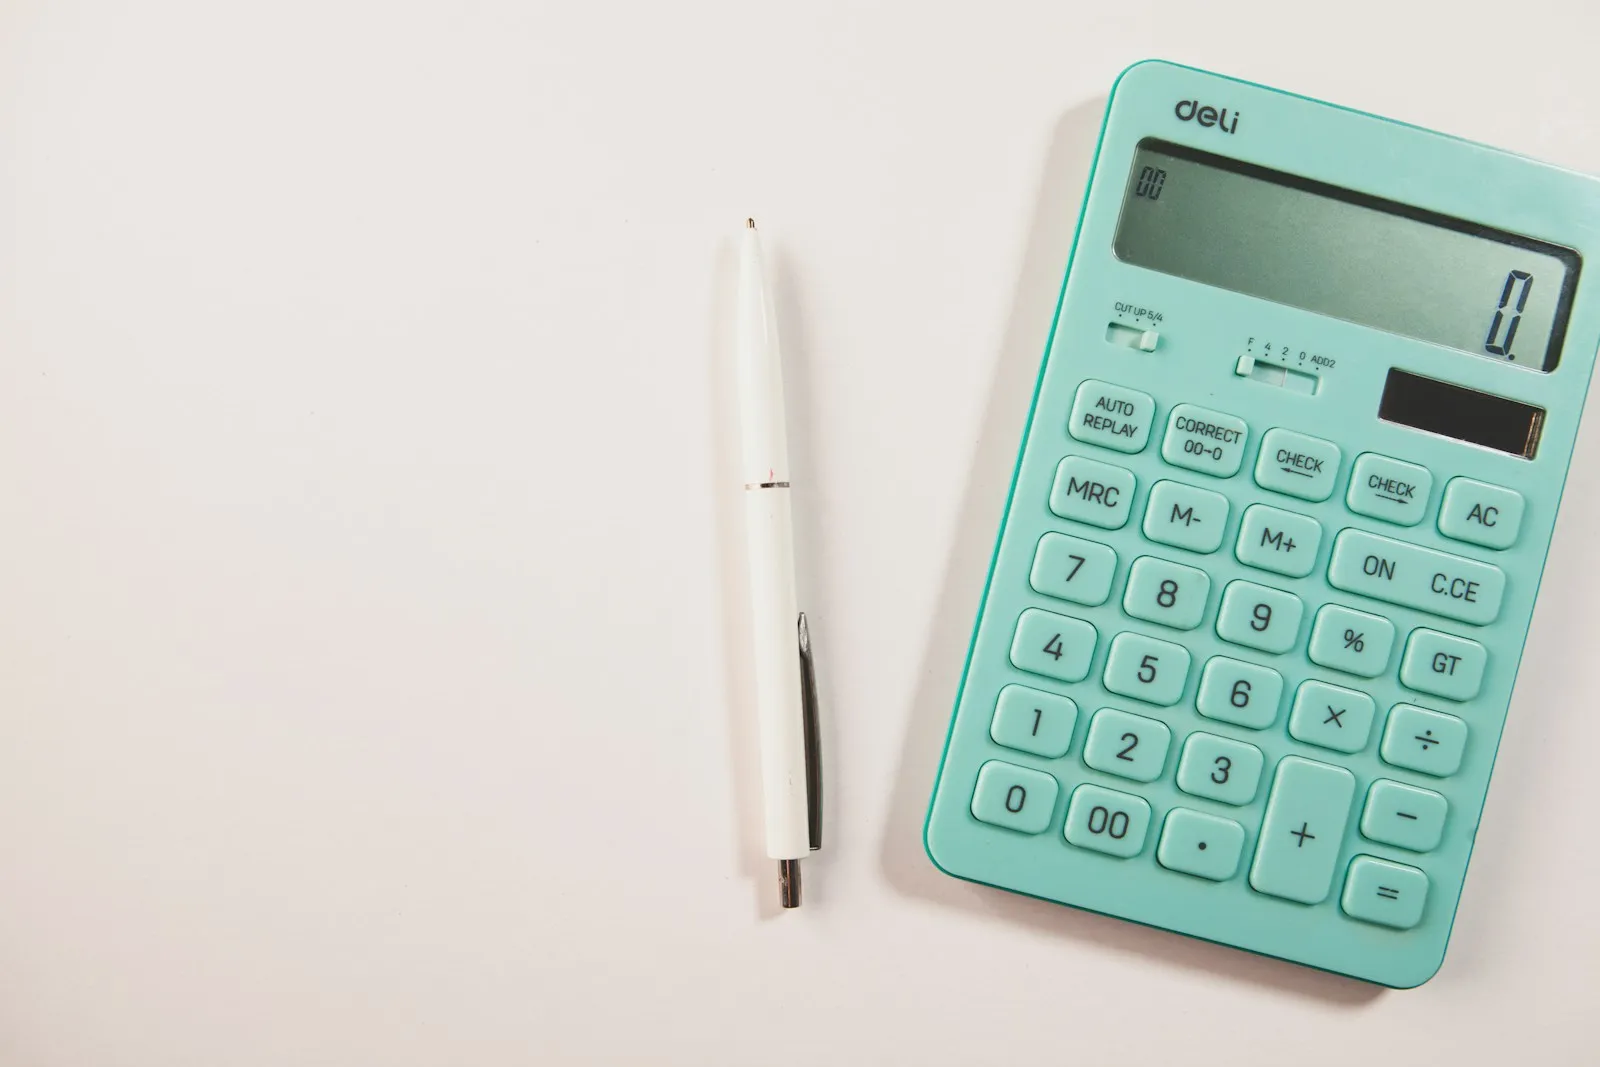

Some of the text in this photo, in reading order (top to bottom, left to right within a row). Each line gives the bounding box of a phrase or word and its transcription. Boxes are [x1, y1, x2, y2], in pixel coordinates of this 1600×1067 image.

[1175, 100, 1239, 134] deli
[1114, 301, 1164, 323] CUT UP 5/4
[1248, 337, 1255, 346] F
[1264, 342, 1272, 351] 4
[1281, 346, 1289, 356] 2
[1310, 354, 1336, 369] ADD2
[1096, 397, 1134, 417] AUTO
[1083, 411, 1137, 437] REPLAY
[1176, 417, 1243, 444] CORRECT
[1276, 450, 1324, 472] CHECK
[1067, 477, 1119, 507] MRC
[1369, 476, 1416, 498] CHECK
[1171, 504, 1201, 526] M-
[1466, 504, 1498, 527] AC
[1261, 528, 1296, 552] M+
[1066, 555, 1085, 581] 7
[1363, 556, 1479, 602] ON C.CE
[1157, 580, 1178, 608] 8
[1251, 604, 1272, 631] 9
[1043, 634, 1062, 660] 4
[1344, 629, 1364, 652] %
[1138, 655, 1158, 683] 5
[1432, 653, 1461, 675] GT
[1231, 680, 1251, 708] 6
[1032, 709, 1042, 736] 1
[1116, 733, 1138, 761] 2
[1211, 756, 1231, 784] 3
[1006, 785, 1026, 813] 0
[1088, 806, 1129, 839] 00
